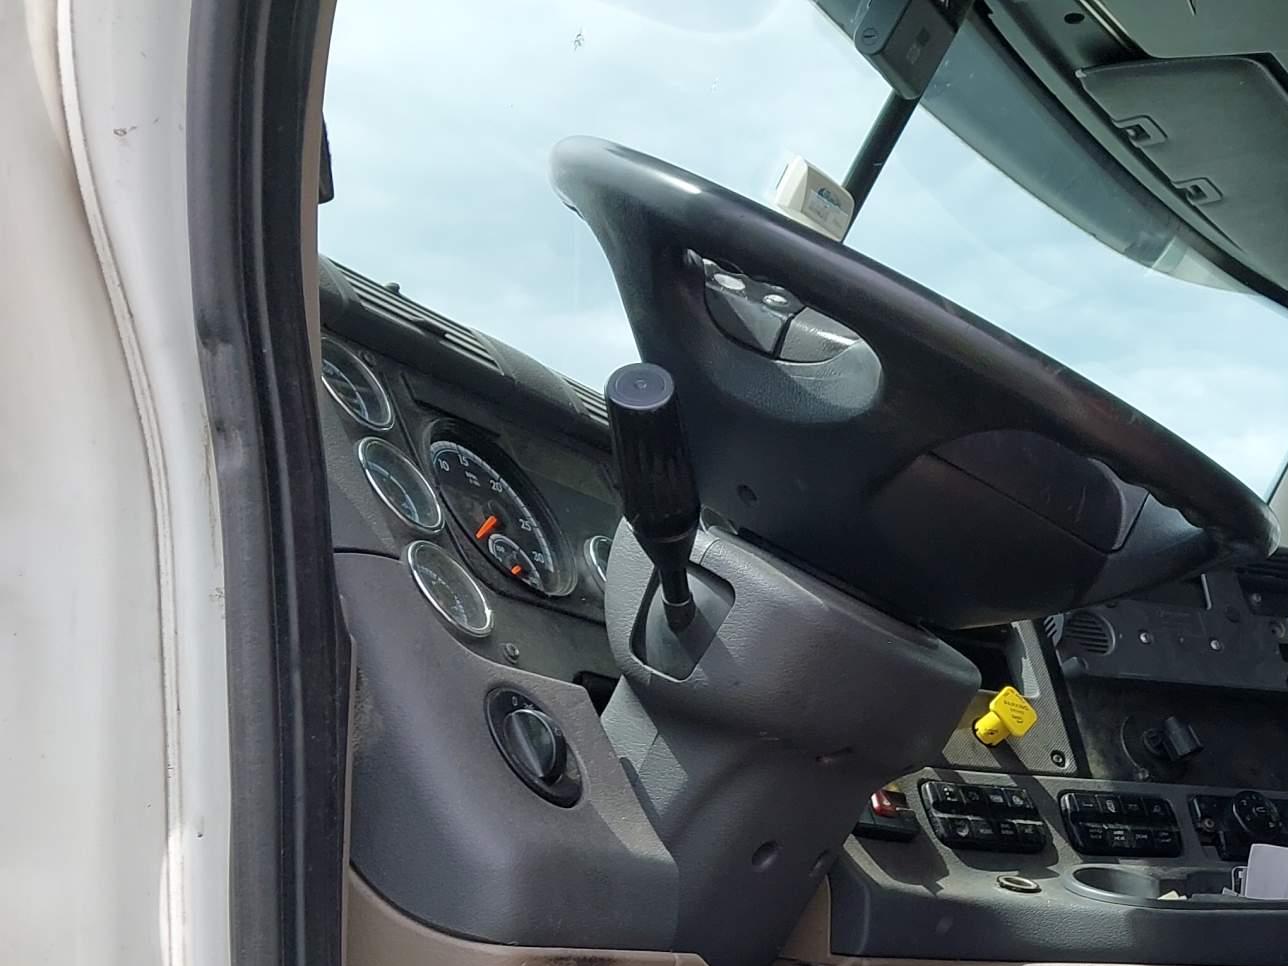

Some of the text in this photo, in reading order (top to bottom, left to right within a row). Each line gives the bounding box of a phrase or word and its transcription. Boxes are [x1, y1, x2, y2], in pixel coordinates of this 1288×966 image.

[438, 459, 450, 472] 10
[458, 454, 469, 466] 15
[490, 480, 502, 492] 20
[519, 519, 531, 531] 25
